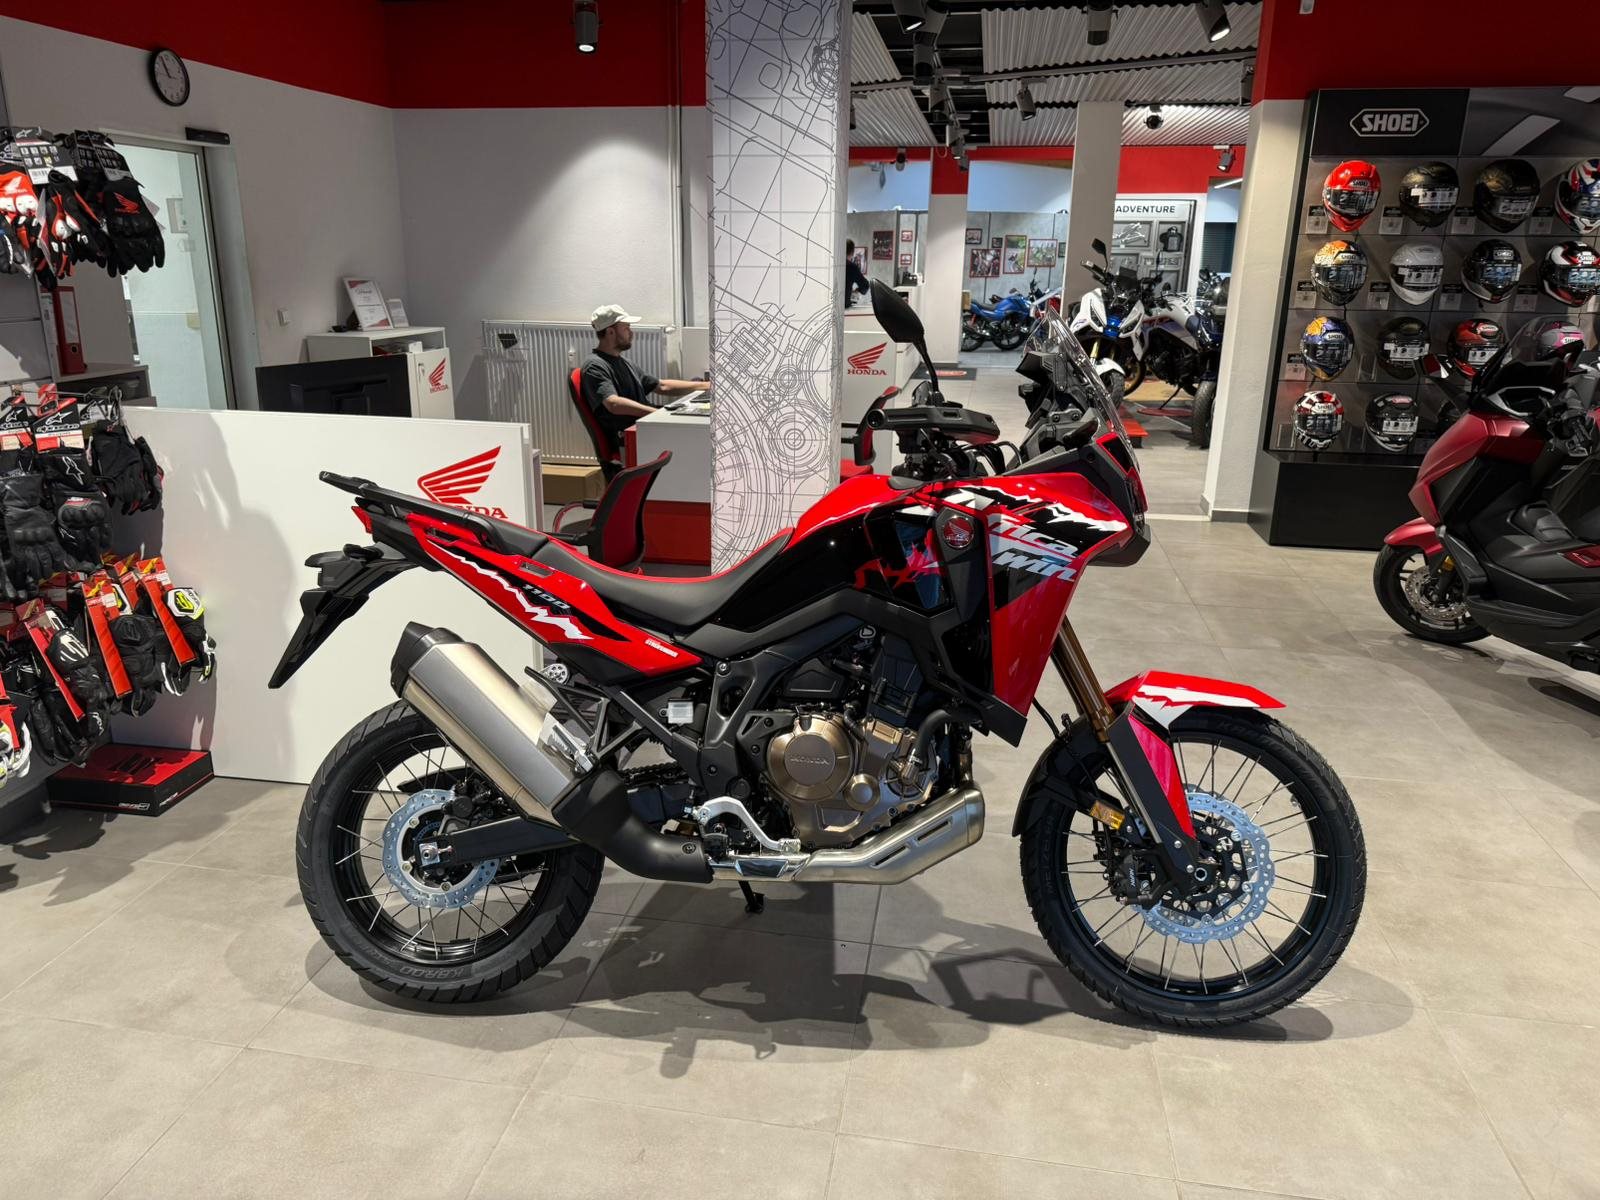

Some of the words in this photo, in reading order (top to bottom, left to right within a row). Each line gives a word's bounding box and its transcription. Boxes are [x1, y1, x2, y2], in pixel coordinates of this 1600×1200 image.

[1361, 113, 1420, 132] SHOEI
[1115, 205, 1177, 214] ADVENTURE
[523, 583, 571, 609] 1100
